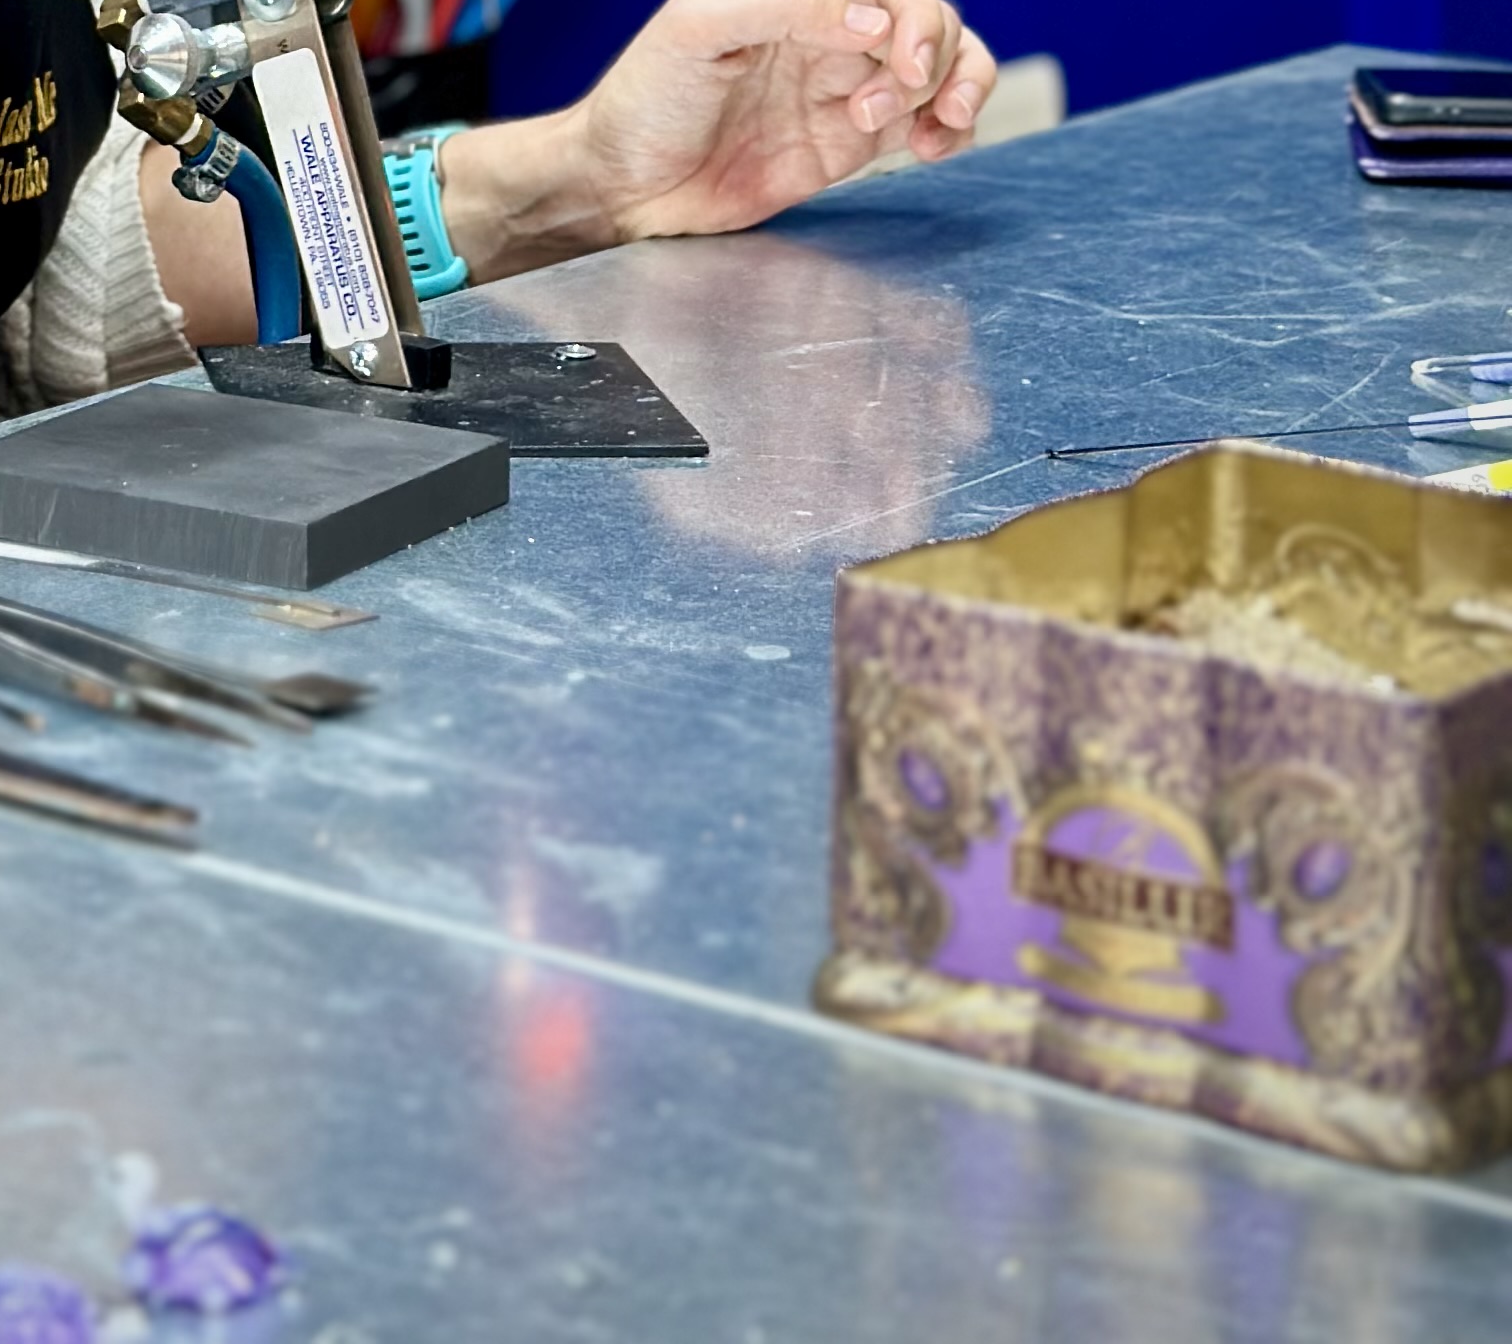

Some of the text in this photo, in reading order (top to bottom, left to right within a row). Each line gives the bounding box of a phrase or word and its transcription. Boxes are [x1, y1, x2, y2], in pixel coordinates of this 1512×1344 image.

[299, 134, 358, 321] WALE APPARATUS CO.
[319, 121, 349, 209] 800-334-WALE
